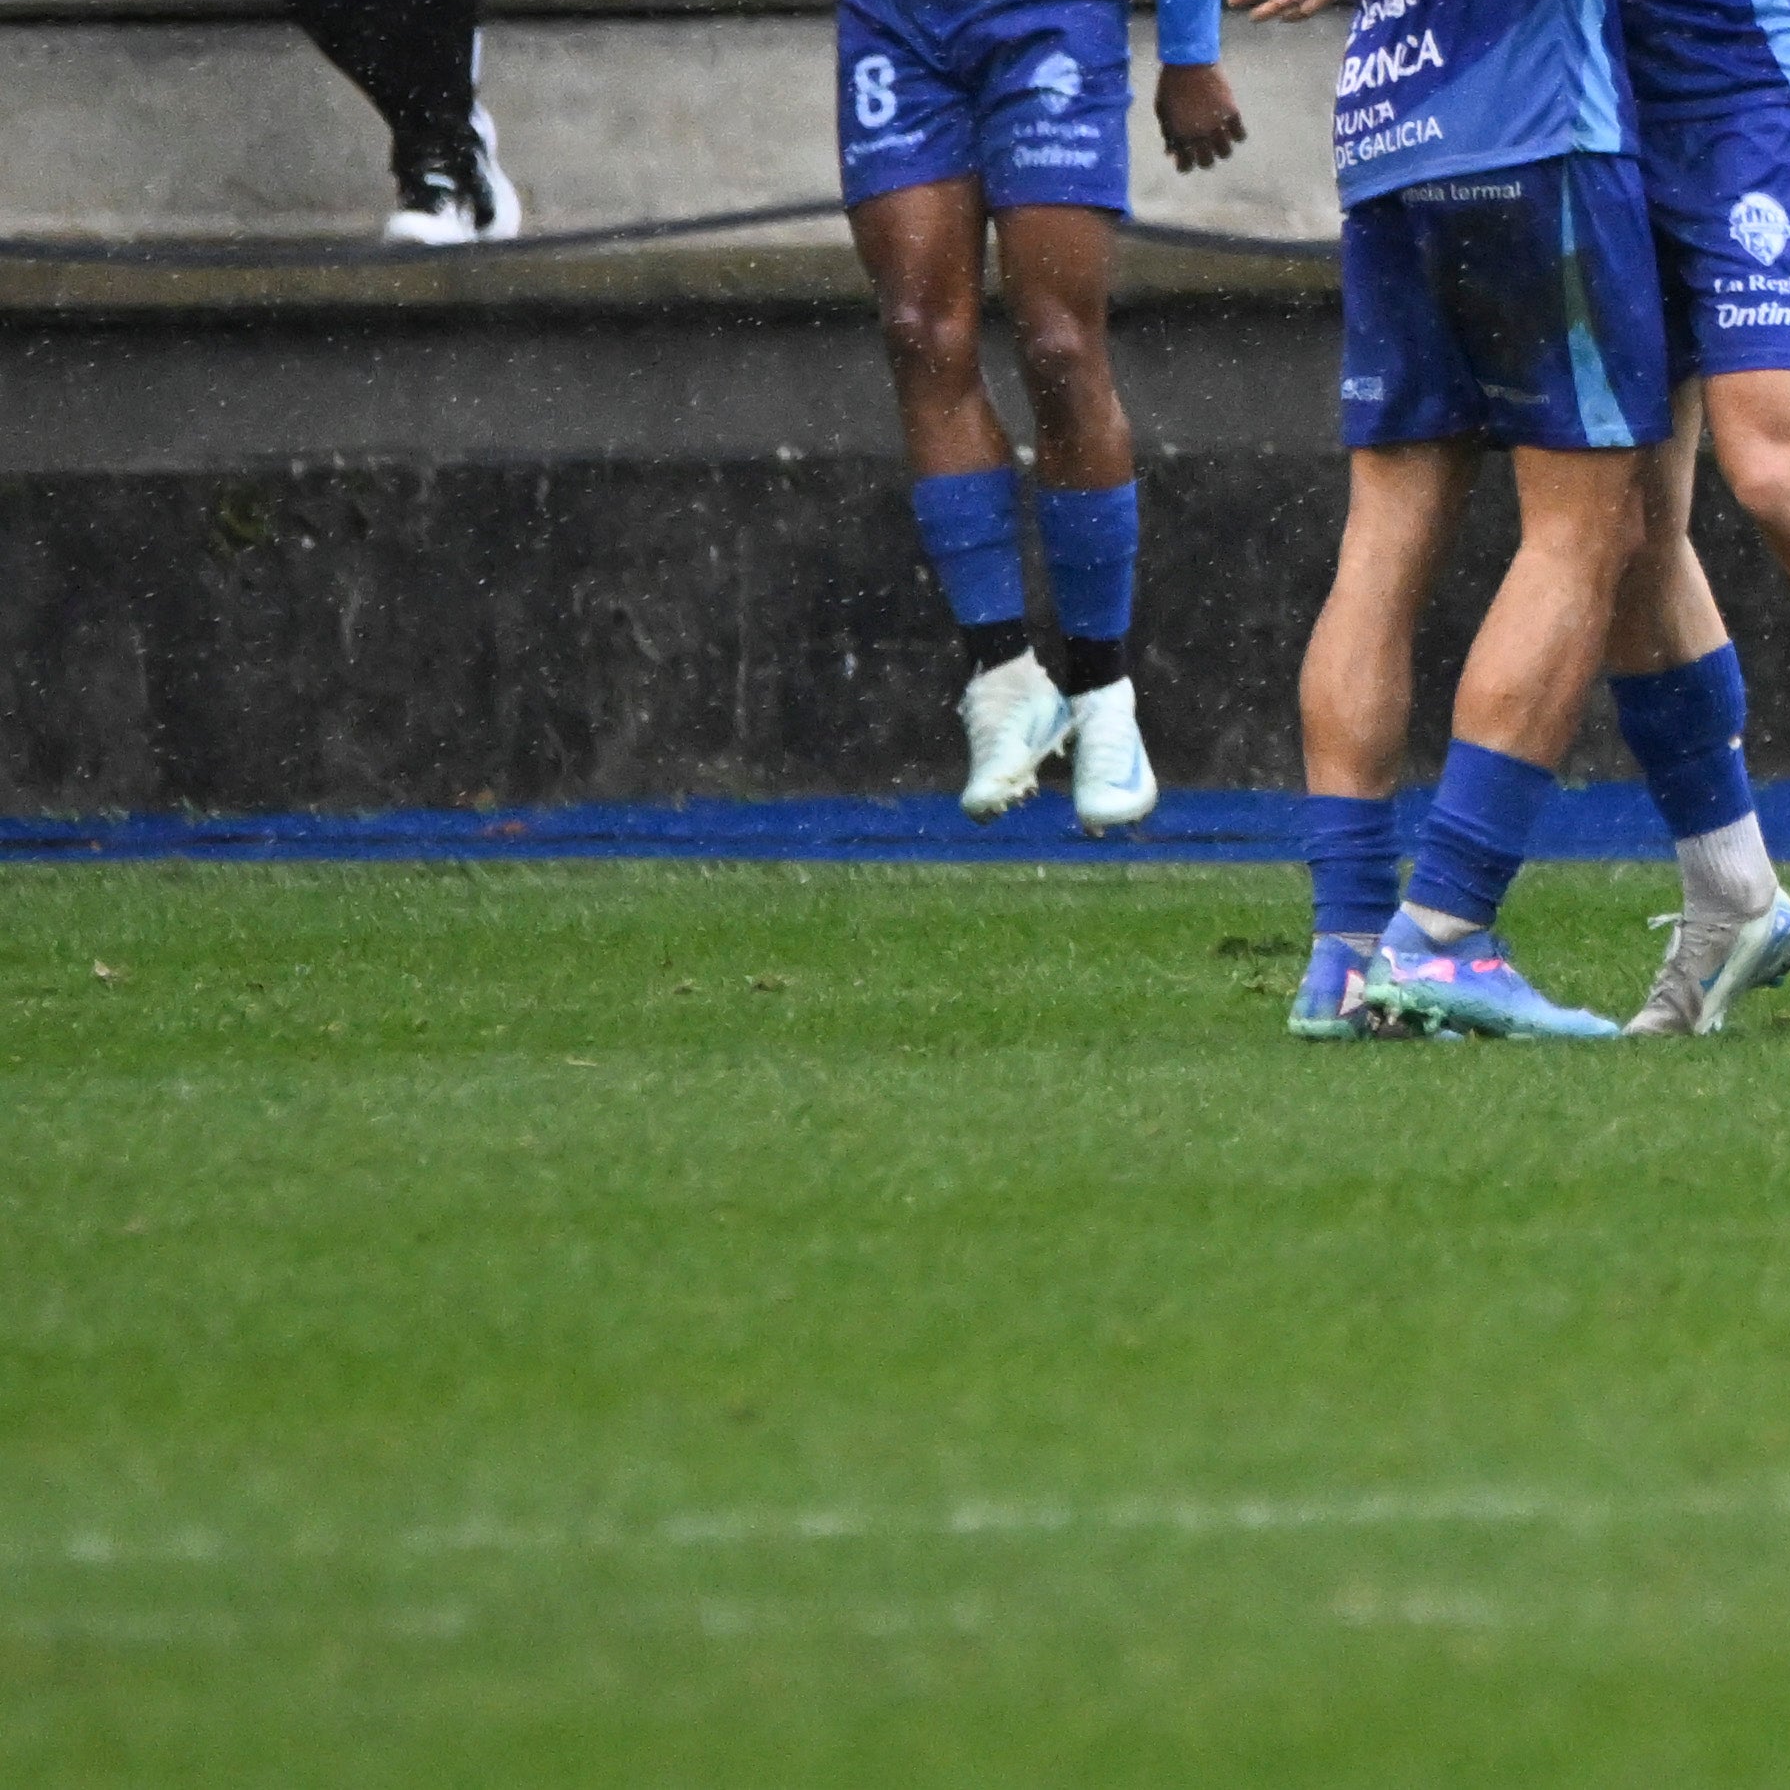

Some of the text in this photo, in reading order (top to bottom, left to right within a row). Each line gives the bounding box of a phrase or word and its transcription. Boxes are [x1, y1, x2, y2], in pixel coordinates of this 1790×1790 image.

[854, 54, 897, 129] 8
[1335, 116, 1443, 170] DE GALICIA
